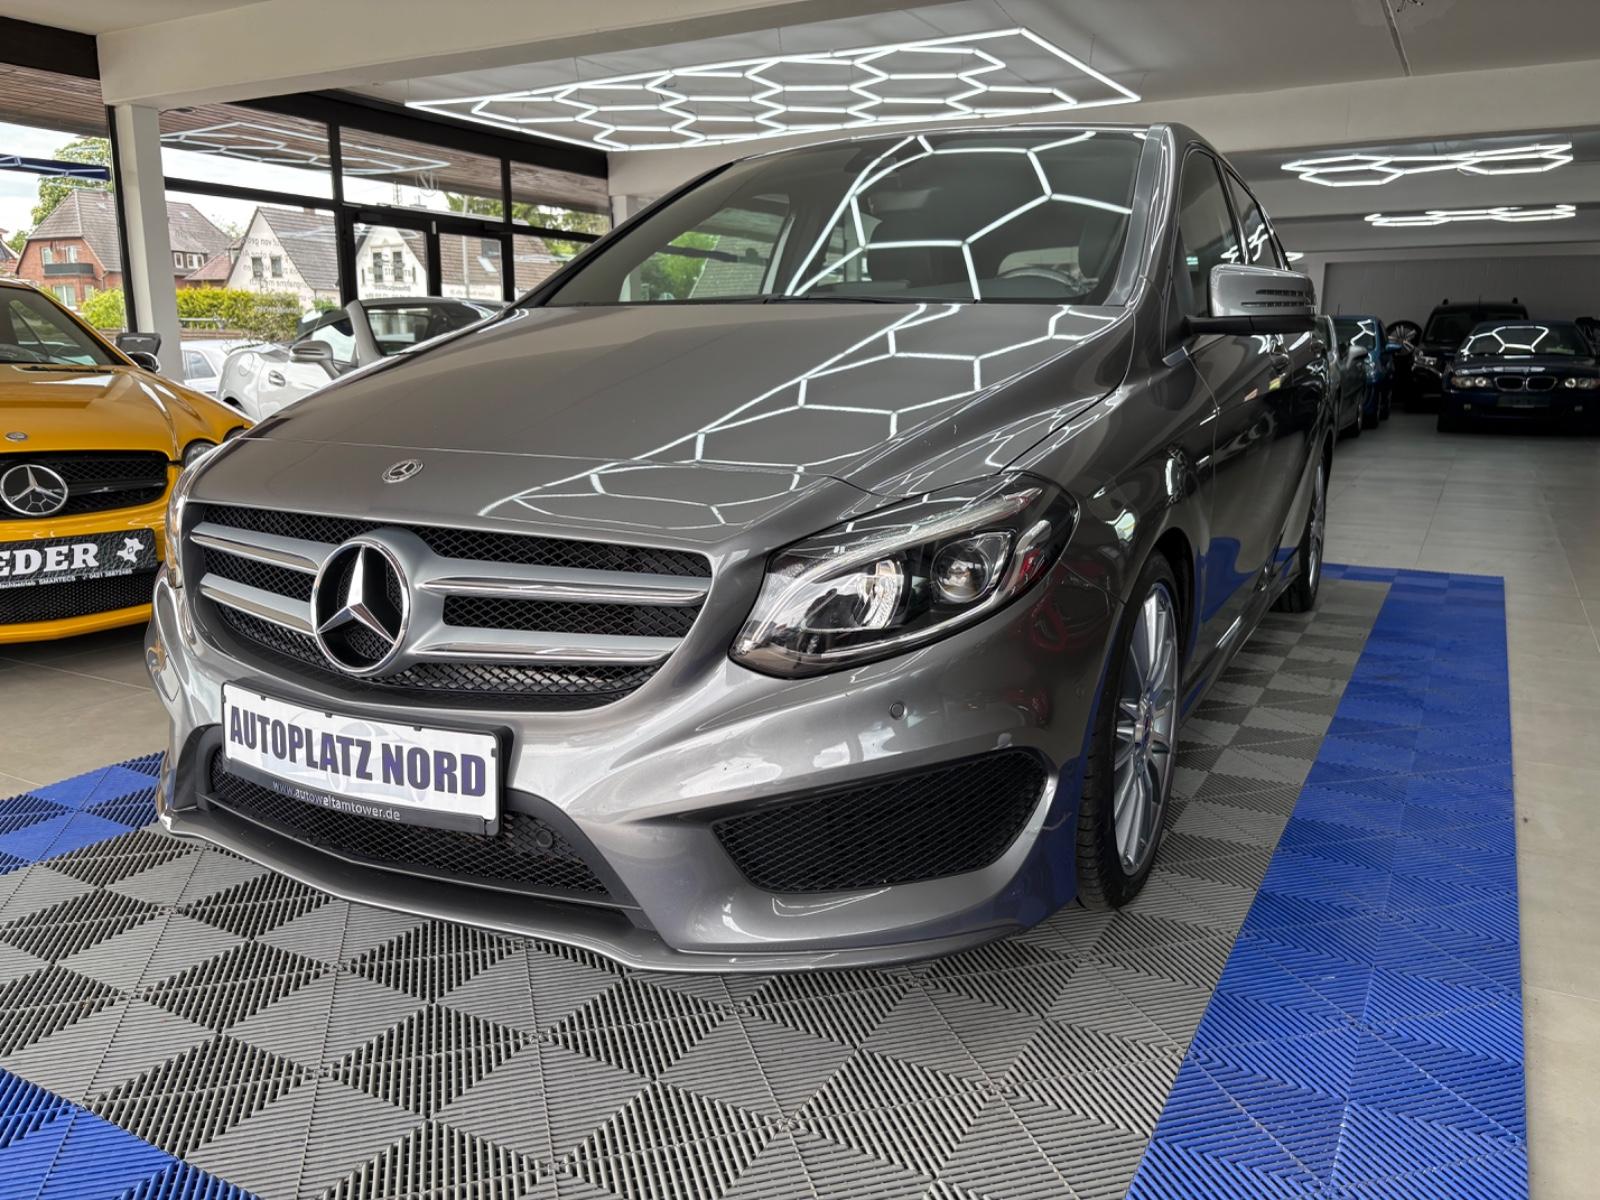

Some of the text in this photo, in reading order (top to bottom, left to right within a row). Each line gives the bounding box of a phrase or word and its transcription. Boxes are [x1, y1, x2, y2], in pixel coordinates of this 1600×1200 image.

[230, 706, 486, 797] AUTOPLATZ NORD
[272, 780, 400, 821] www.autoweltamtower.de
